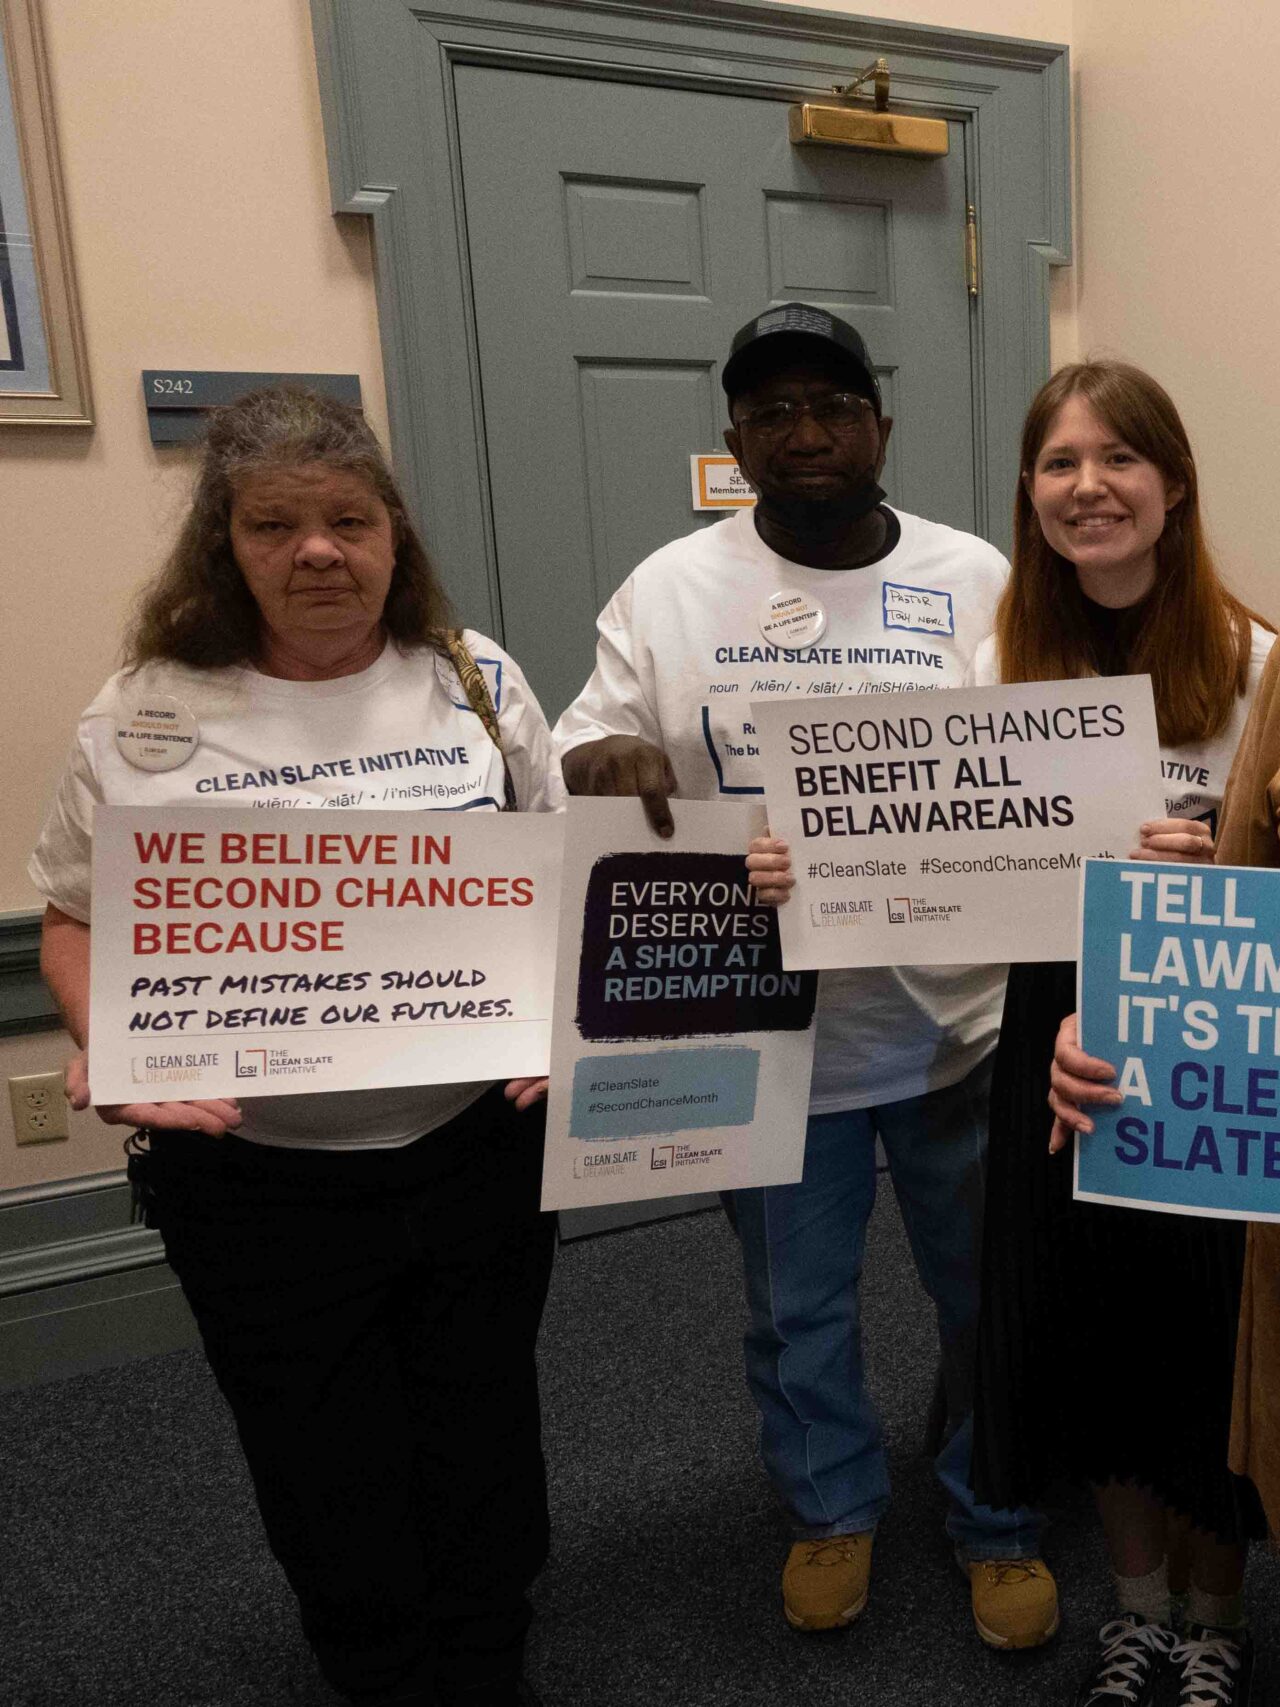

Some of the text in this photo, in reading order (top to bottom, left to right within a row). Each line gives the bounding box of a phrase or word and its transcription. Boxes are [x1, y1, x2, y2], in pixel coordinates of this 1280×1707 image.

[154, 379, 193, 394] S242
[777, 597, 802, 608] RECORD
[779, 619, 791, 627] LIFE
[791, 610, 819, 623] SENTENC
[715, 646, 945, 670] CLEAN SLATE INITIATIVE
[709, 682, 739, 694] noun
[145, 710, 176, 719] RECORD
[136, 732, 153, 740] LIFE
[153, 733, 193, 744] SENTENCE
[788, 704, 1125, 756] SECOND CHANCES
[725, 744, 745, 756] The
[195, 746, 470, 794] CLEAN SLATE INITIATIVE
[795, 755, 1022, 797] BENEFIT ALL
[801, 795, 1075, 838] DELAWAREANS
[134, 832, 451, 865] WE BELIEVE IN
[807, 859, 907, 879] #CleanSlate
[133, 877, 534, 910] SECOND CHANCES
[1120, 871, 1256, 928] TELL
[820, 900, 874, 915] CLEAN SLATE
[912, 898, 927, 906] THE
[912, 905, 962, 914] CLEAN SLATE
[821, 914, 863, 928] DELAWARE
[891, 912, 905, 921] CSI
[913, 913, 951, 922] INITIATIVE
[609, 913, 770, 938] DESERVES
[133, 921, 345, 955] BECAUSE
[605, 944, 767, 970] A SHOT AT
[130, 968, 486, 998] PAST MISTAKES SHOULD
[604, 974, 801, 1003] REDEMPTION
[128, 998, 514, 1032] NOT DEFINE OUR FUTURES.
[1118, 995, 1219, 1051] IT'S
[146, 1053, 219, 1069] CLEAN SLATE
[269, 1049, 288, 1058] THE
[269, 1056, 333, 1066] CLEAN SLATE
[146, 1069, 202, 1083] DELAWARE
[239, 1065, 258, 1074] CSI
[269, 1065, 317, 1075] INITIATIVE
[589, 1077, 660, 1093] #CleanSlate
[1117, 1056, 1153, 1107] A
[588, 1093, 719, 1113] #SecondChanceMonth
[675, 1149, 722, 1160] CLEAN SLATE
[676, 1144, 691, 1152] THE
[584, 1151, 638, 1167] CLEAN SLATE
[653, 1160, 667, 1168] CSI
[675, 1157, 711, 1166] INITIATIVE
